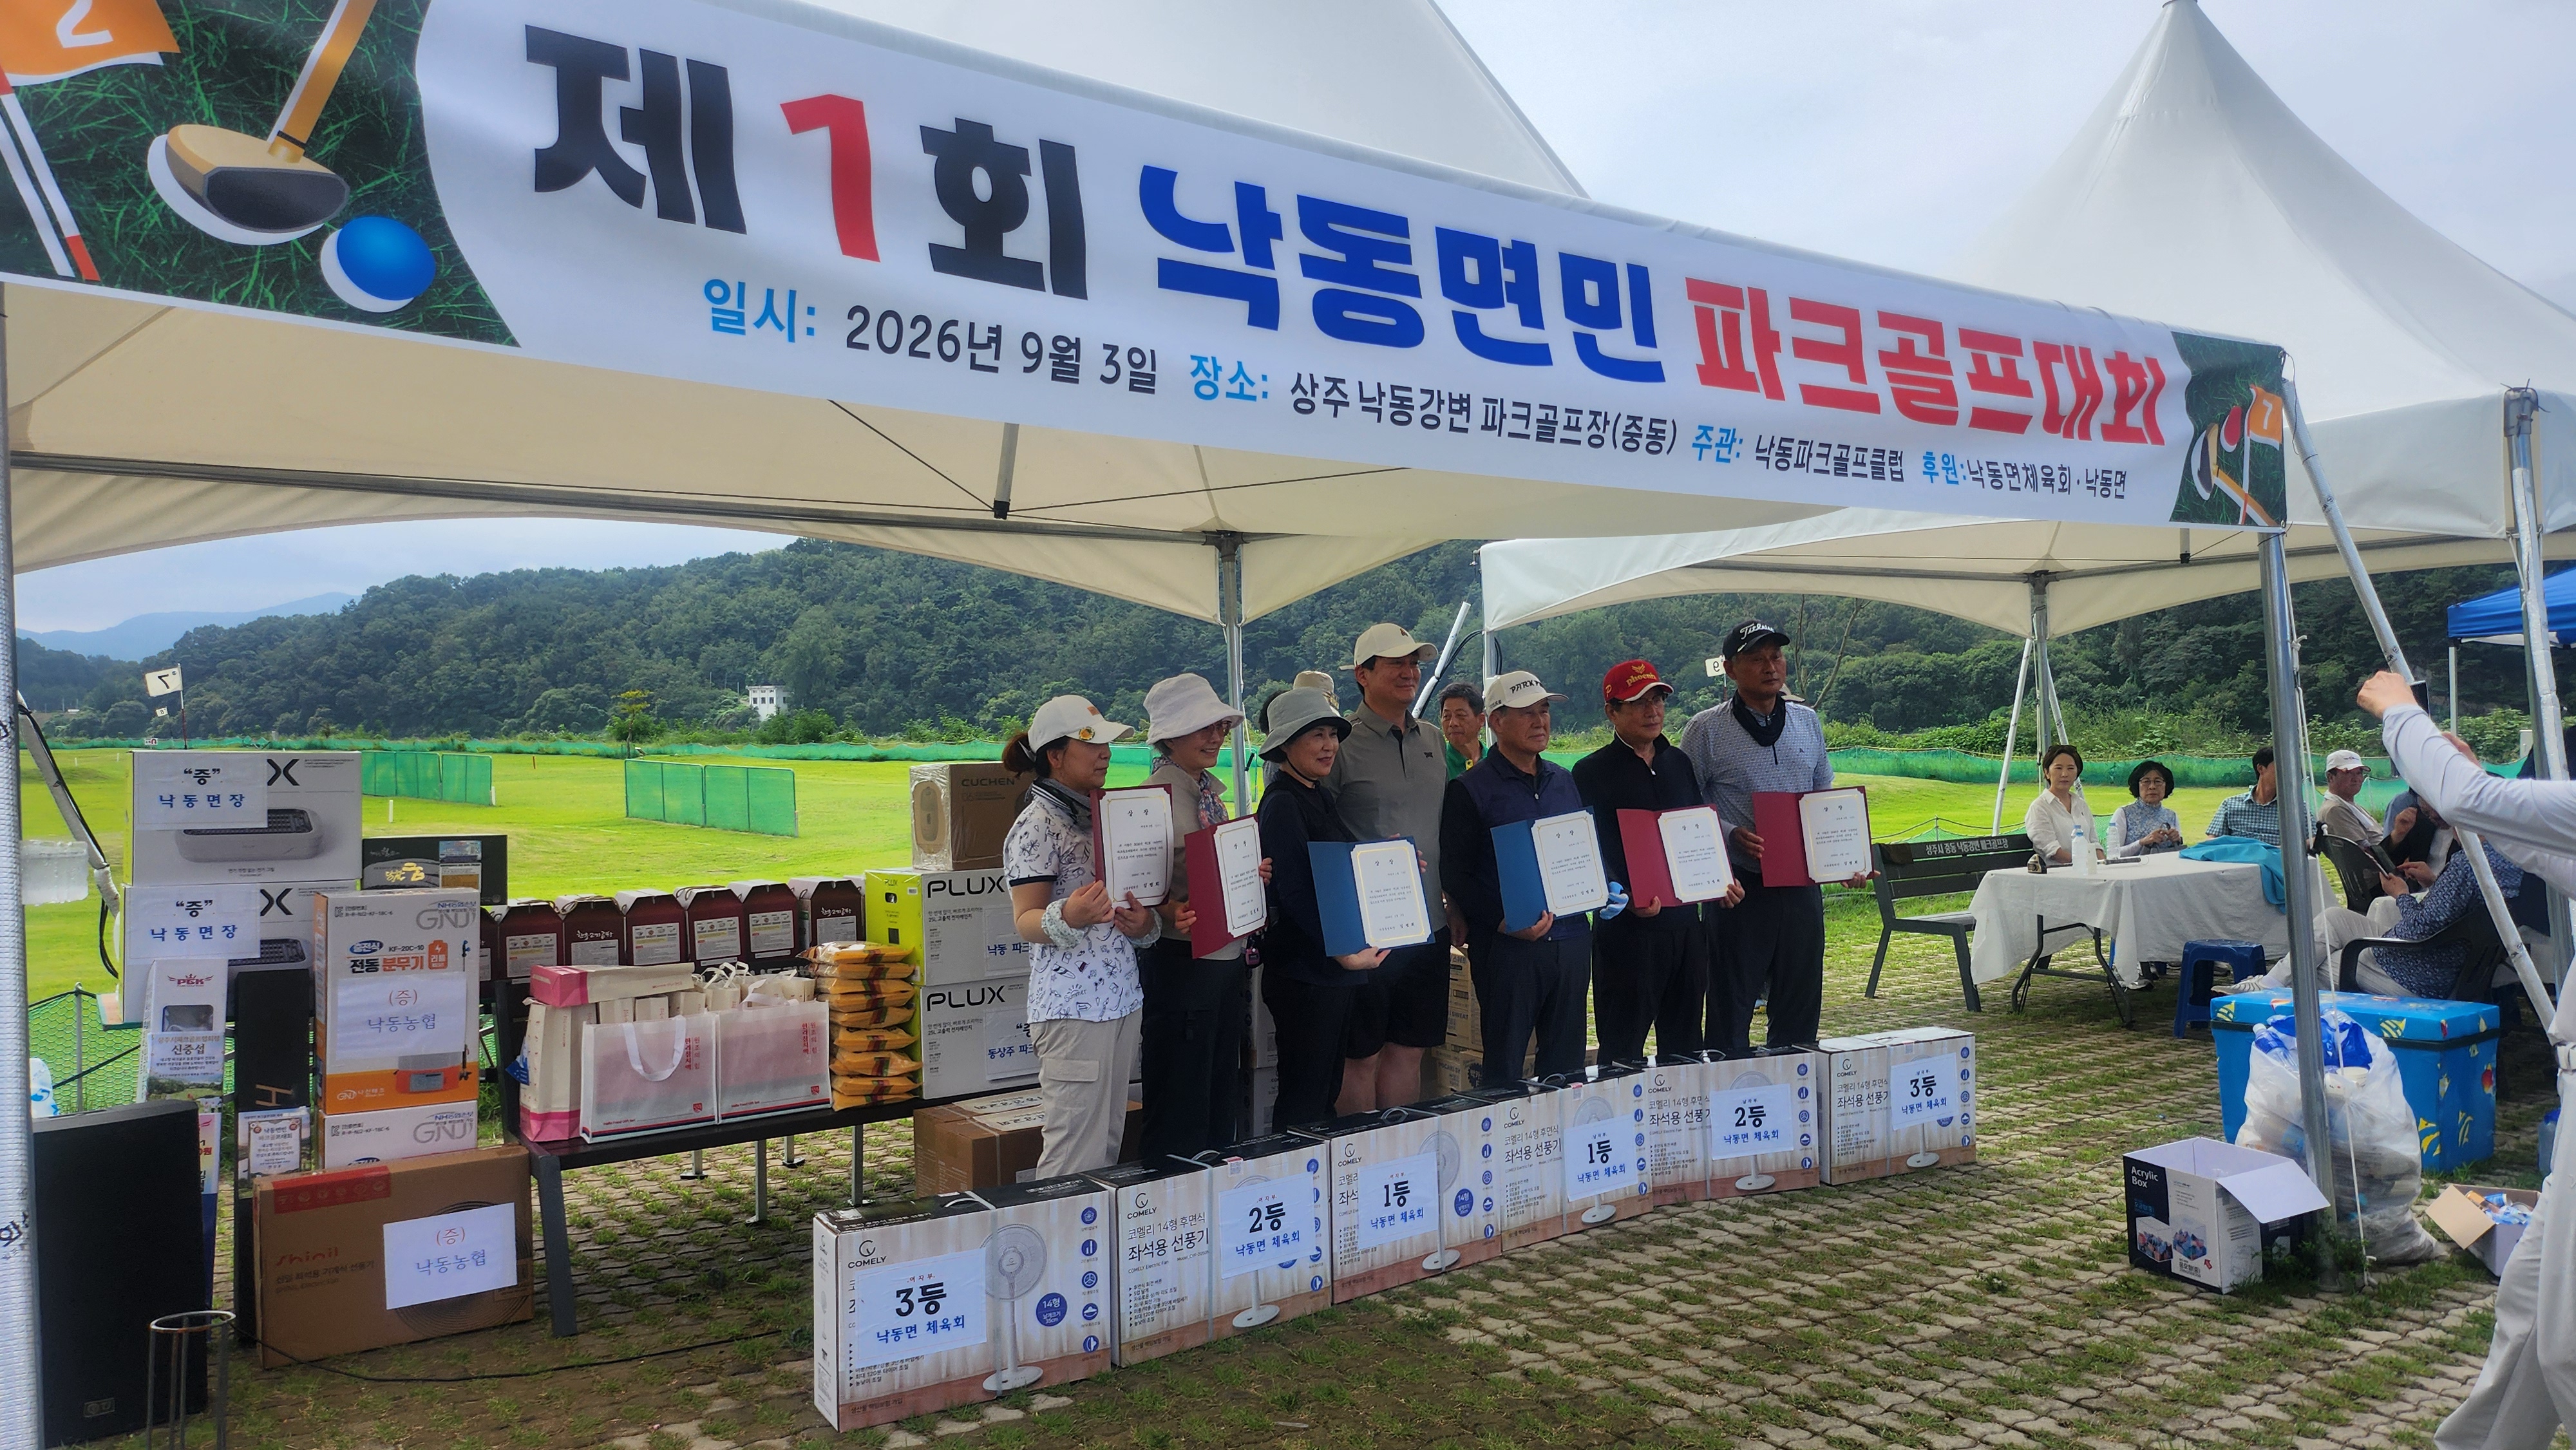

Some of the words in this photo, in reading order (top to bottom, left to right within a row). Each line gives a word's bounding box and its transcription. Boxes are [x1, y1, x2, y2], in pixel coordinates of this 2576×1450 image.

[1139, 164, 1665, 383] 낙동면민
[1685, 277, 2166, 446] 파크골프대회
[703, 278, 817, 343] 일시:
[846, 304, 1003, 374] 2026년
[1022, 332, 1082, 384] 9월
[1101, 344, 1157, 395] 3일
[1190, 354, 1269, 403] 장소:
[1291, 372, 1350, 418] 상주
[1359, 381, 1471, 435] 낙동강변
[1482, 397, 1677, 456] 파크골프장(중동)
[1692, 424, 1743, 462] 주관:
[1755, 433, 1904, 483] 낙동파크골프클럽
[1926, 843, 1944, 855] 상주시
[1944, 843, 1956, 854] 중동
[927, 875, 1005, 898] PLUX
[353, 941, 381, 952] 충전식
[988, 944, 1007, 956] 낙동
[350, 957, 380, 973] 전동
[382, 956, 424, 971] 분무기
[927, 985, 1005, 1012] PLUX
[367, 1013, 437, 1033] 낙동농협
[171, 1044, 205, 1055] 신중섭
[988, 1046, 1015, 1059] 동상주
[1857, 1080, 1870, 1090] 14형
[1910, 1075, 1936, 1098] 3등
[1649, 1098, 1671, 1109] 코멜리
[1672, 1097, 1689, 1107] 14형
[1837, 1095, 1864, 1109] 좌석용
[1902, 1104, 1922, 1115] 낙동면
[1926, 1097, 1947, 1110] 체육회
[1504, 1119, 1525, 1129] COMELY
[1649, 1111, 1680, 1126] 좌석용
[1734, 1106, 1766, 1128] 2등
[1504, 1135, 1523, 1146] 코멜리
[1525, 1129, 1539, 1140] 14형
[1540, 1125, 1559, 1138] 후면식
[1723, 1135, 1748, 1145] 낙동면
[1754, 1130, 1779, 1142] 체육회
[1505, 1146, 1531, 1163] 좌석용
[1534, 1138, 1562, 1157] 선풍기
[1587, 1140, 1612, 1164] 1등
[1338, 1157, 1362, 1167] COMELY
[1578, 1171, 1600, 1184] 낙동면
[1604, 1164, 1625, 1176] 체육회
[2131, 1166, 2158, 1182] Acrylic
[2132, 1176, 2148, 1188] Box
[1385, 1180, 1410, 1207] 1등
[1127, 1207, 1157, 1219] COMELY
[1249, 1202, 1286, 1233] 2등
[1370, 1214, 1396, 1229] 낙동면
[1401, 1207, 1424, 1223] 체육회
[1128, 1228, 1155, 1241] 코멜리
[1157, 1219, 1177, 1234] 14형
[1180, 1212, 1206, 1229] 후면식
[1128, 1238, 1168, 1262] 좌석용
[1172, 1228, 1209, 1252] 선풍기
[1236, 1239, 1266, 1256] 낙동면
[1272, 1230, 1300, 1248] 체육회
[417, 1248, 486, 1276] 낙동농협
[848, 1256, 887, 1268] COMELY
[895, 1281, 947, 1317] 3등
[1043, 1297, 1060, 1308] 14형
[876, 1326, 918, 1344] 낙동면
[926, 1315, 965, 1335] 체육회
